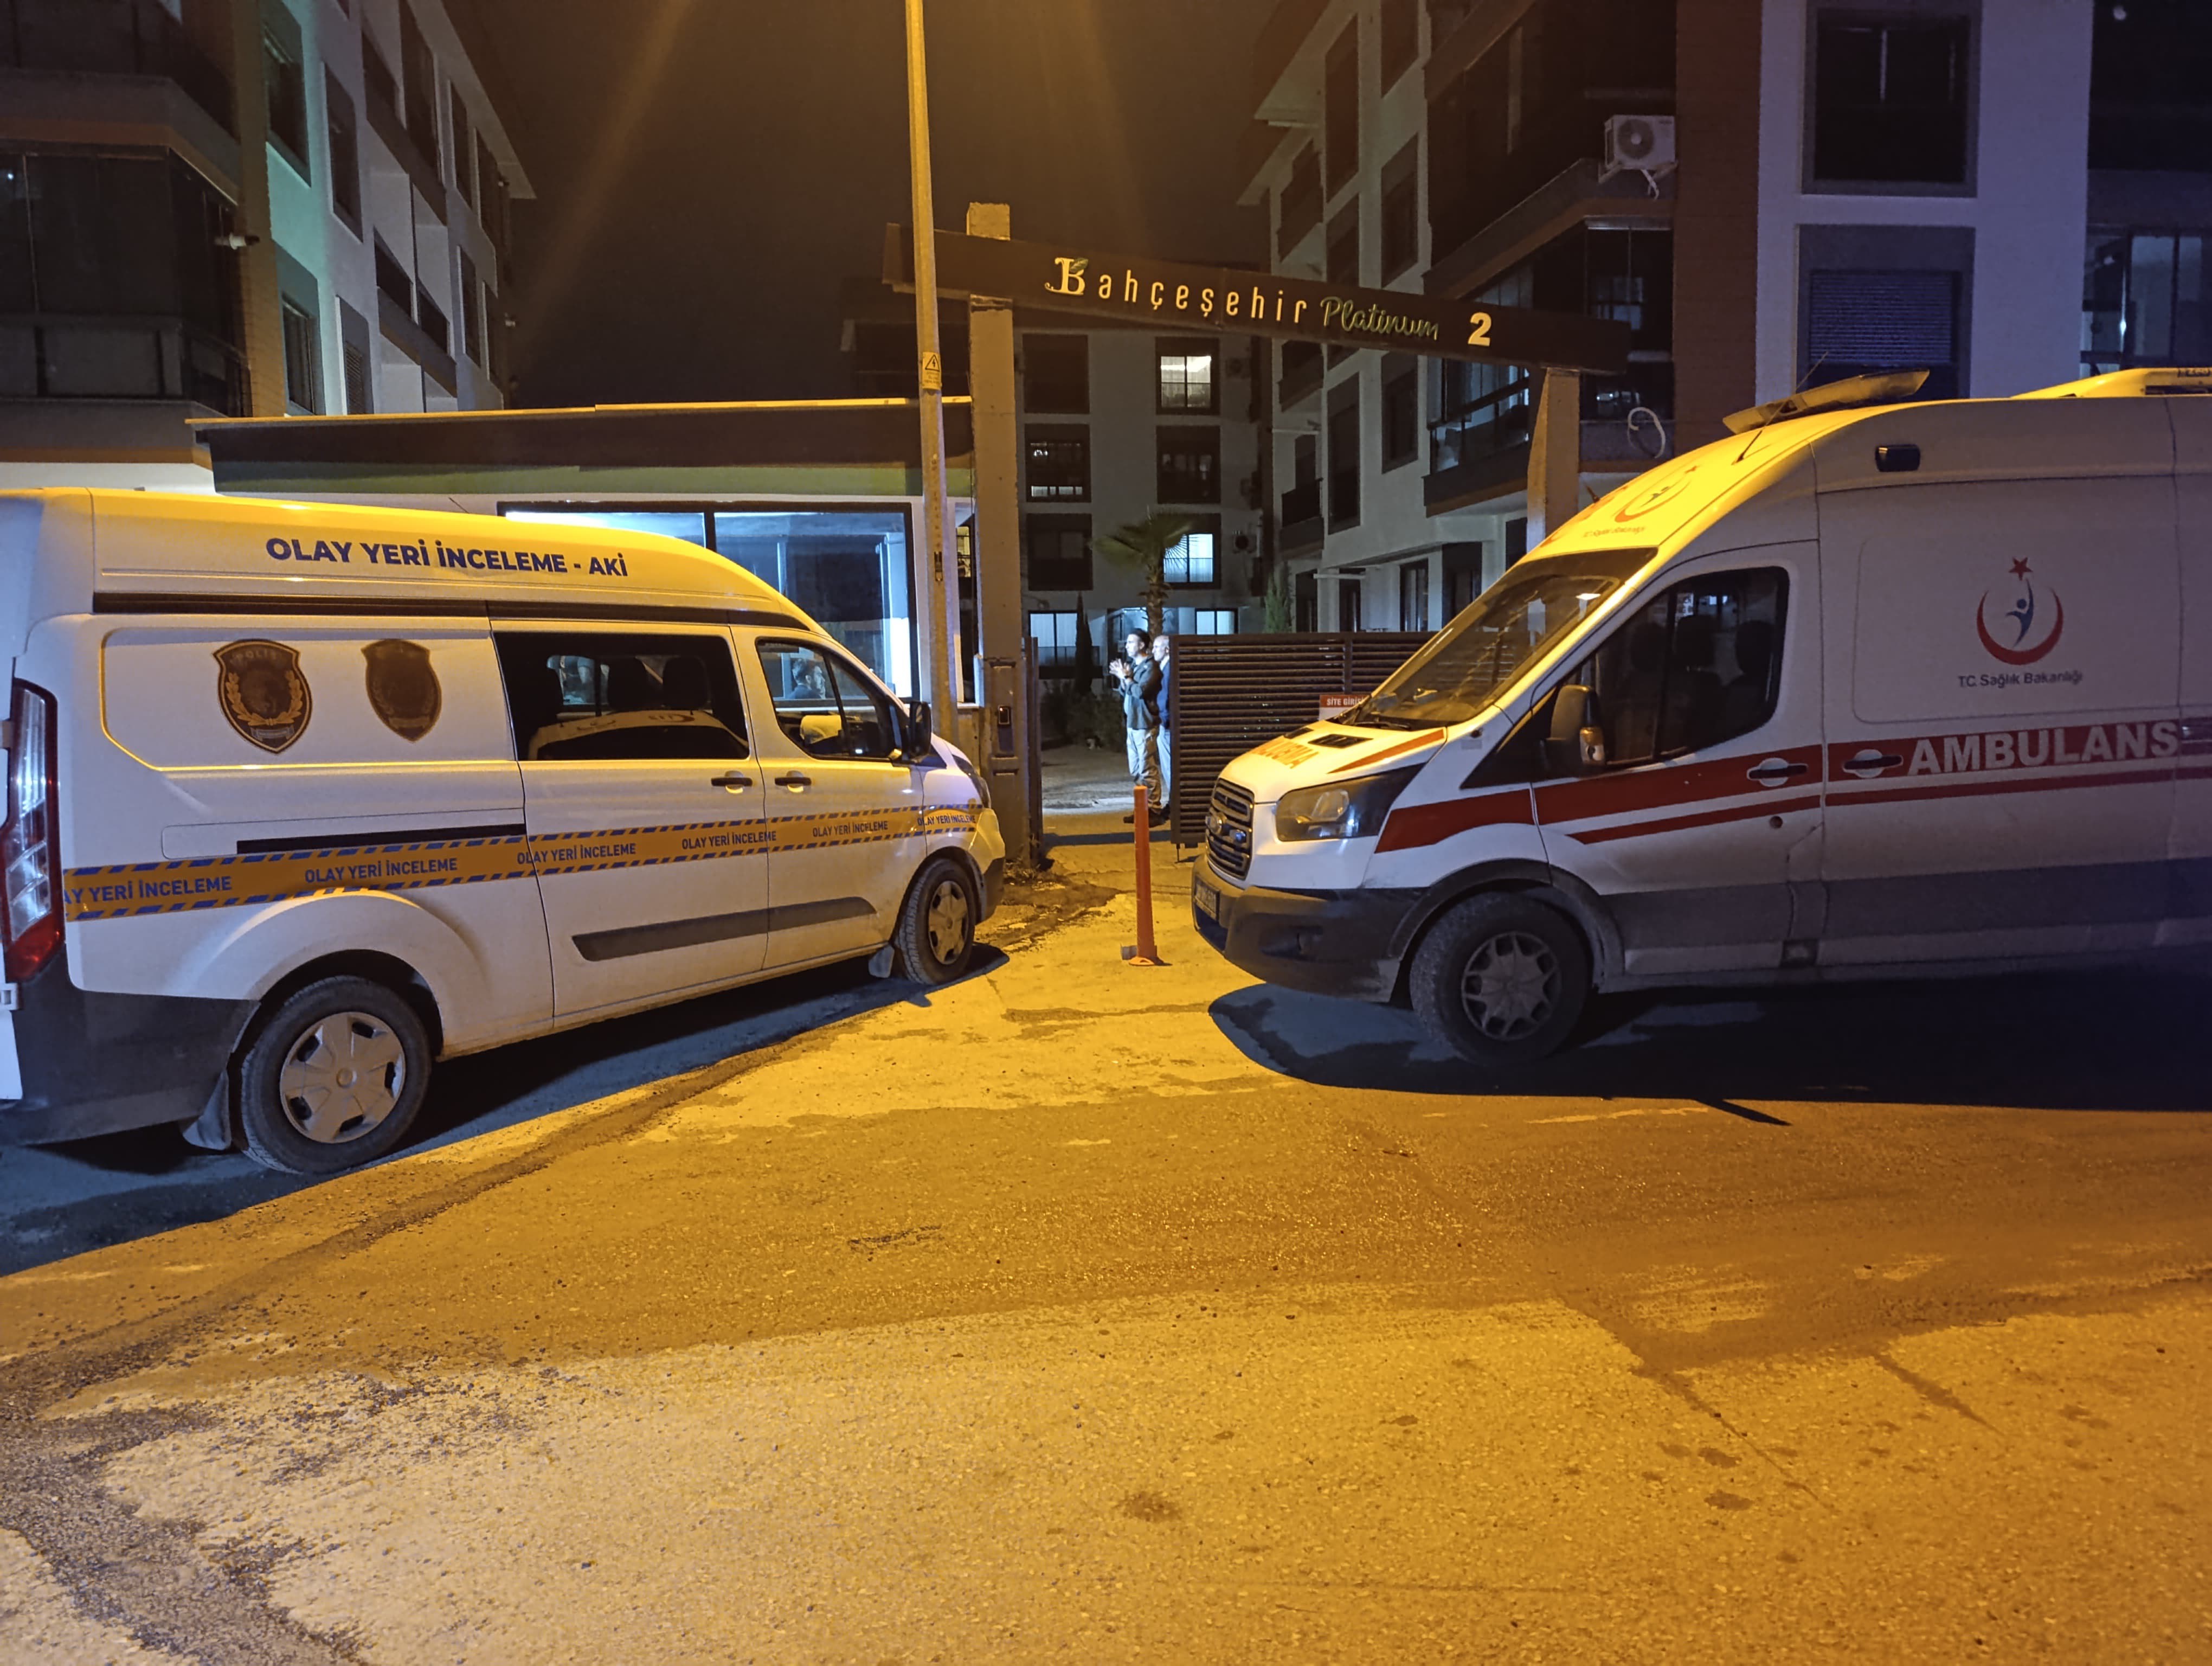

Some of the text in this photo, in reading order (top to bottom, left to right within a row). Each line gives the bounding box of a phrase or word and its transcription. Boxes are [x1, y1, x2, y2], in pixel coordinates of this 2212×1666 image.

[1044, 257, 1492, 347] Bahçeşehir Platinum 2
[266, 537, 351, 562] OLAY
[360, 539, 430, 566] YERİ
[436, 540, 567, 573] İNCELEME
[589, 553, 628, 576] AKİ
[1327, 697, 1341, 706] SİTE
[1907, 721, 2178, 777] AMBULANS
[681, 830, 777, 850] OLAY YERİ İNCELEME
[813, 820, 889, 837] OLAY YERİ İNCELEME
[517, 842, 636, 865] OLAY YERİ İNCELEME
[305, 857, 458, 883] OLAY YERİ İNCELEME
[63, 876, 232, 906] AY YERİ İNCELEME
